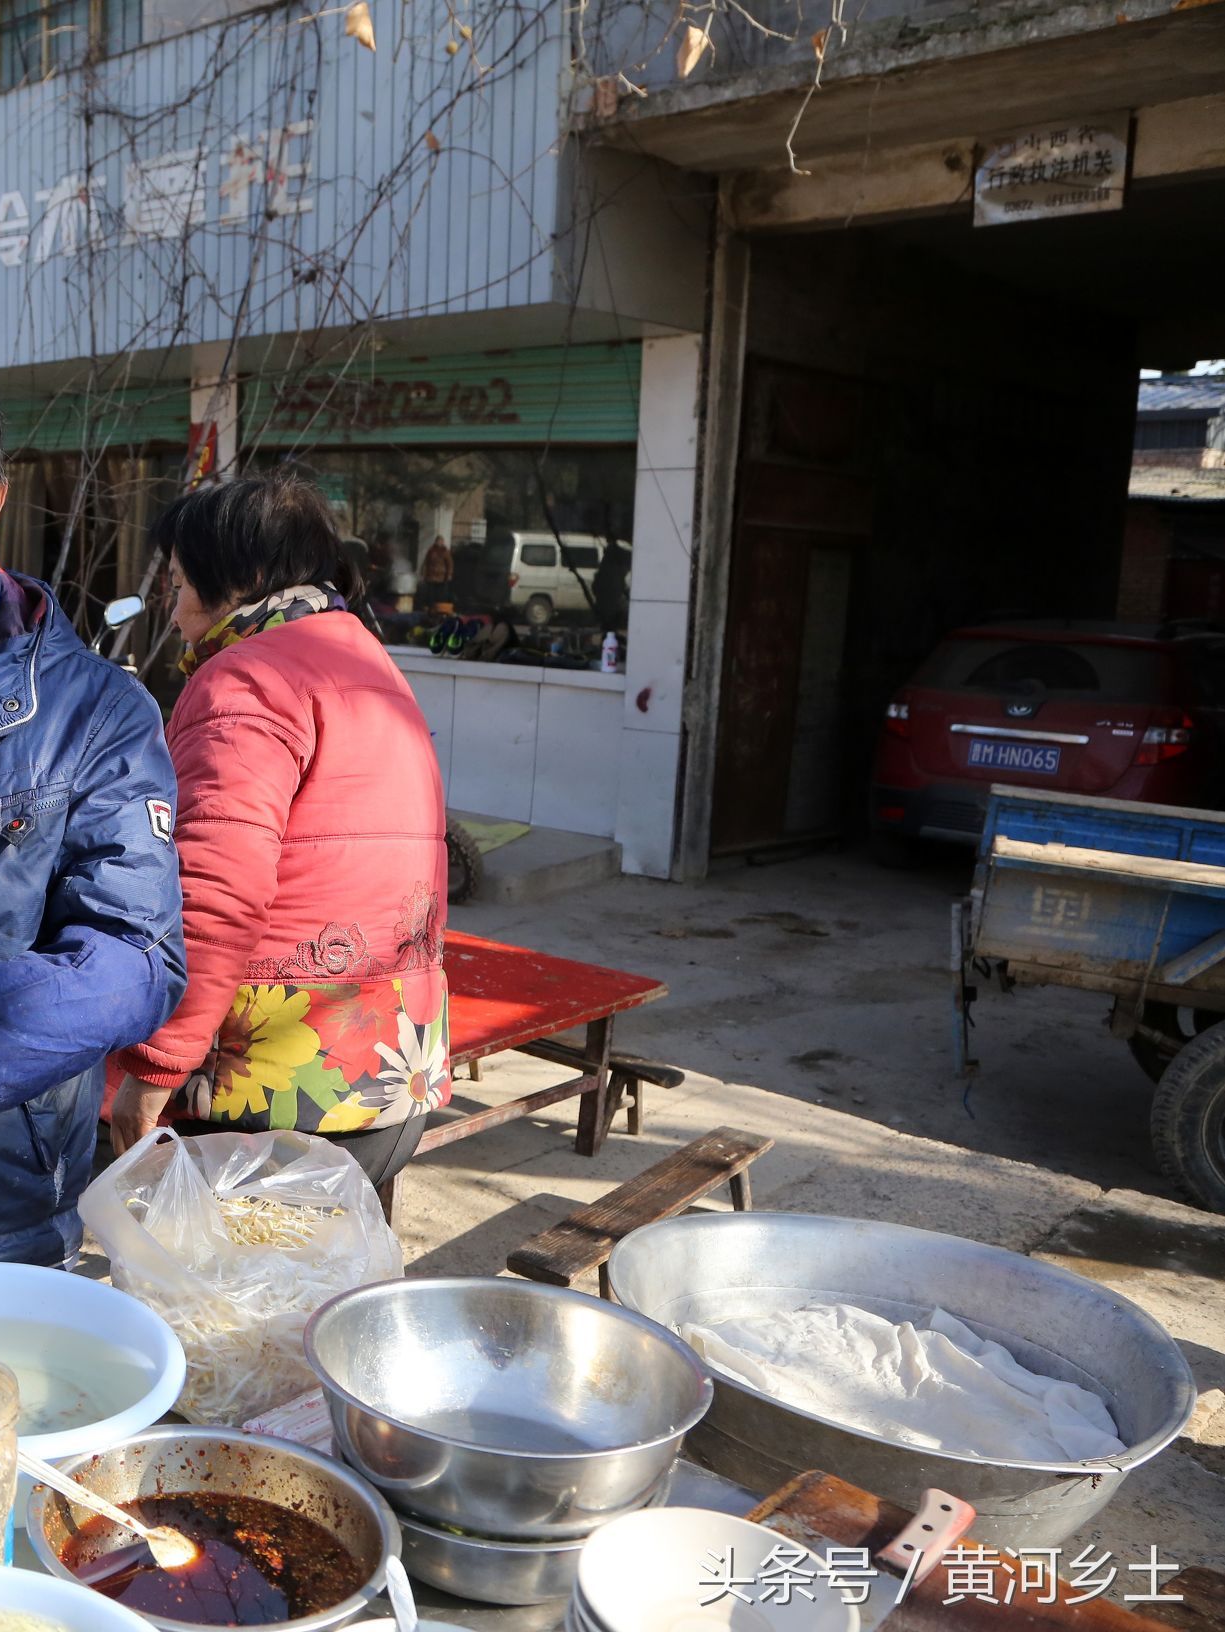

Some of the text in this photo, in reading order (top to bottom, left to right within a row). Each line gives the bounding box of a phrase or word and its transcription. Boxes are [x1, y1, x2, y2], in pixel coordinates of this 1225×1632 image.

[988, 149, 1113, 190] 行政执法机关
